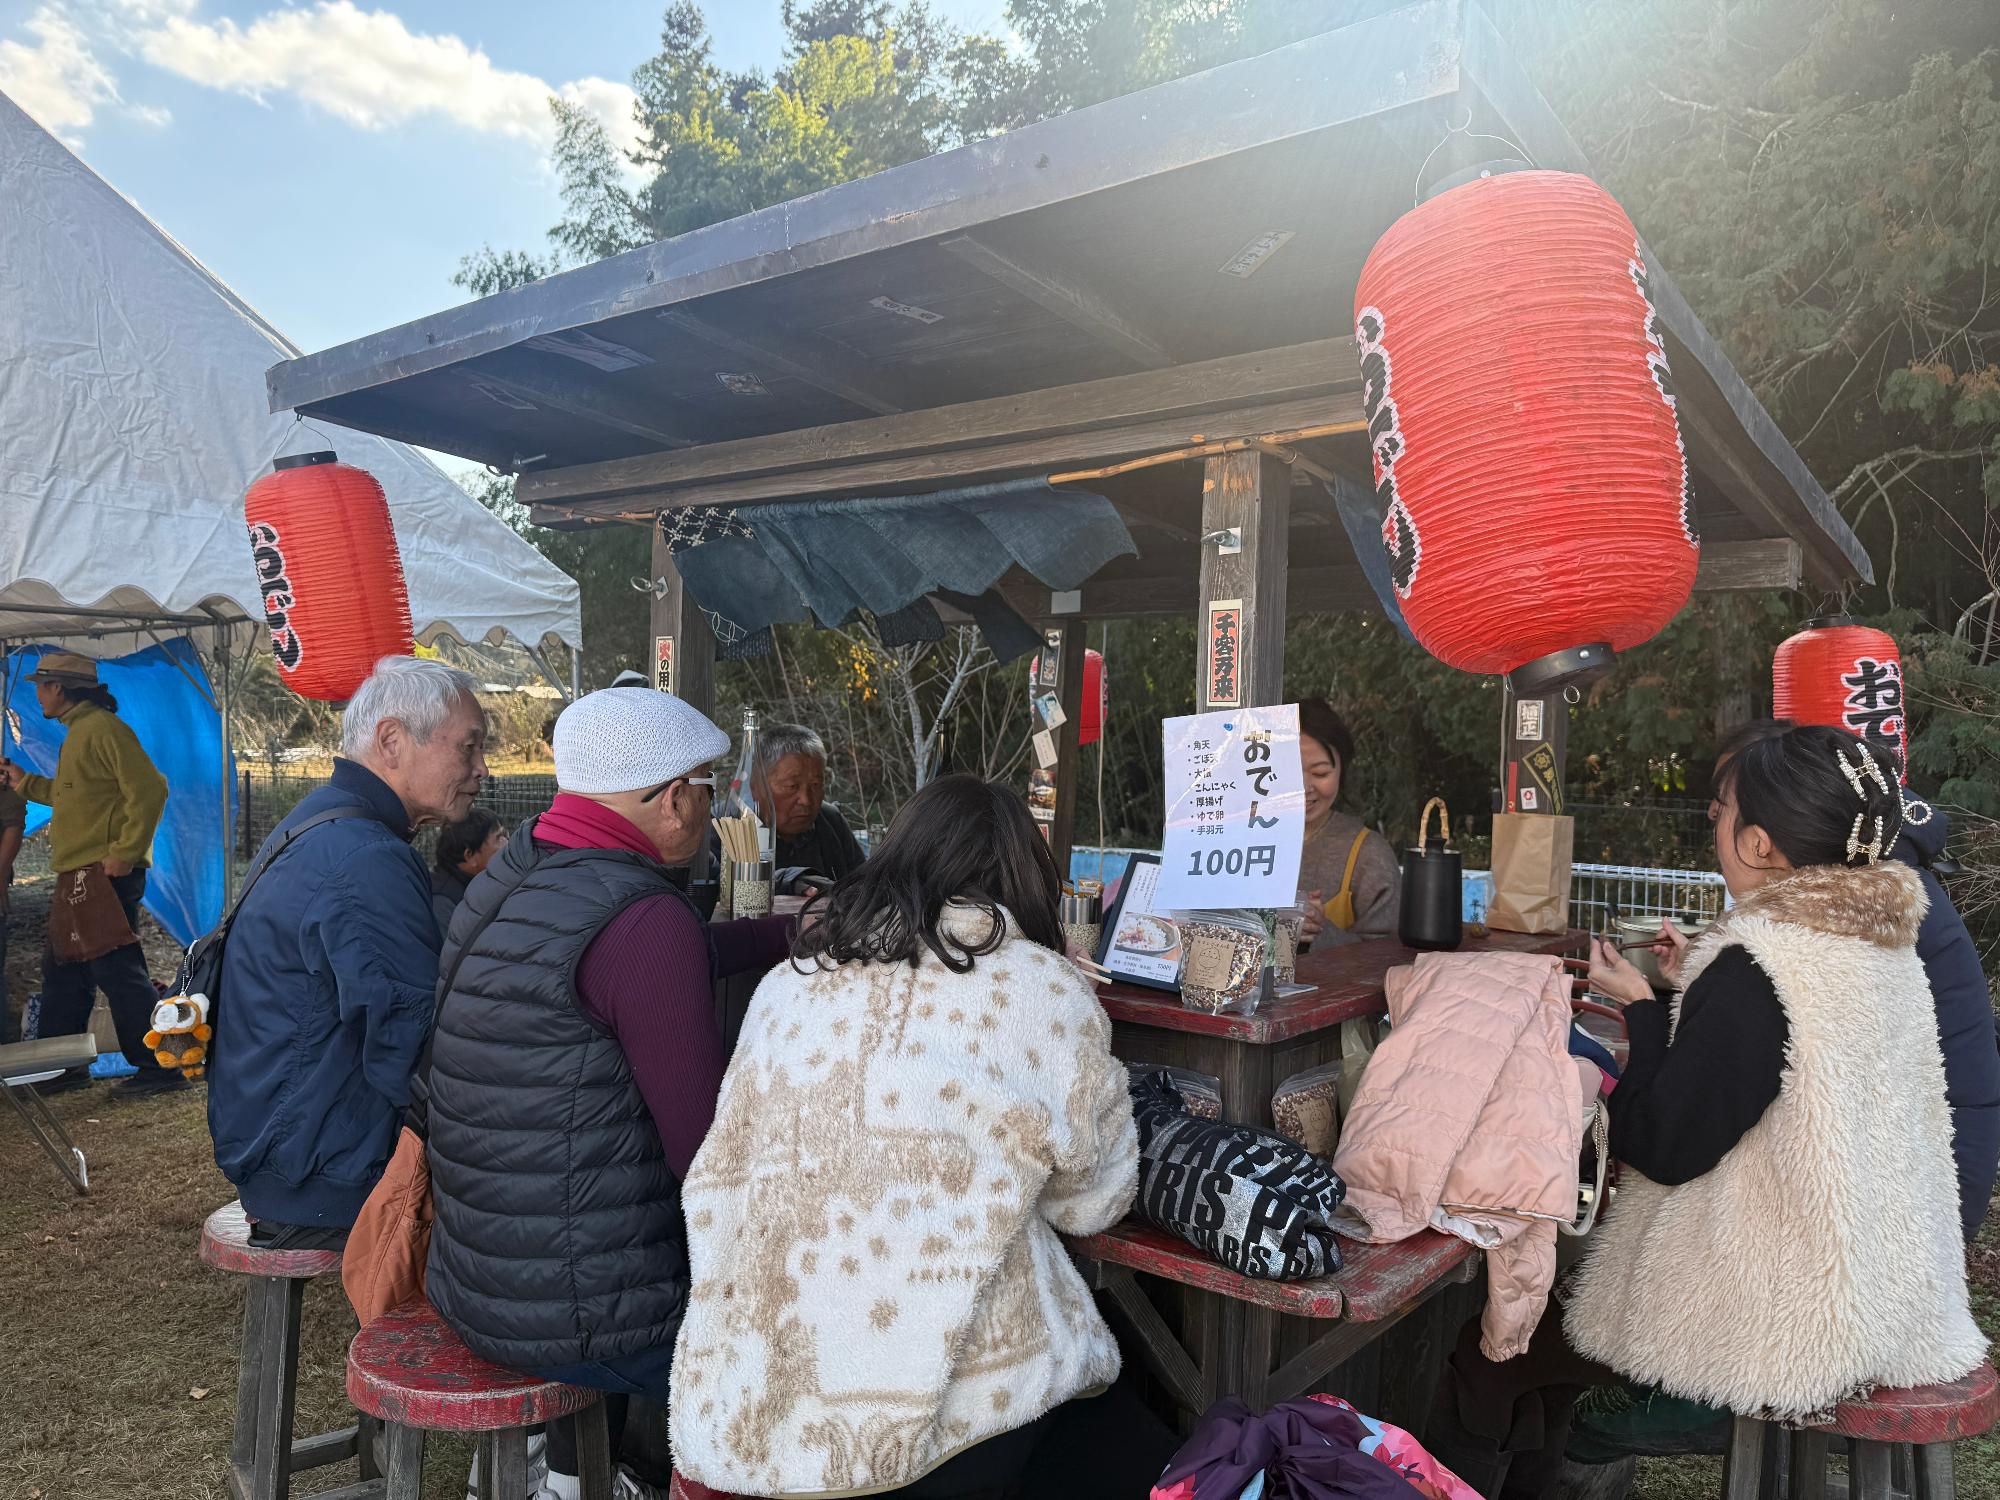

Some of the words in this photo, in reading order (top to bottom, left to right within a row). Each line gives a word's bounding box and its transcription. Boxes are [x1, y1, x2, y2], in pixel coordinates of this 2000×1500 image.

[658, 640, 672, 694] 火の用
[1193, 739, 1210, 751] 角天
[1243, 729, 1280, 829] おでん
[1195, 780, 1237, 793] こんにゃく
[1196, 795, 1224, 808] 厚揚げ
[1197, 810, 1224, 821] ゆで卵
[1196, 824, 1224, 836] 手羽元
[1187, 845, 1277, 878] 100円
